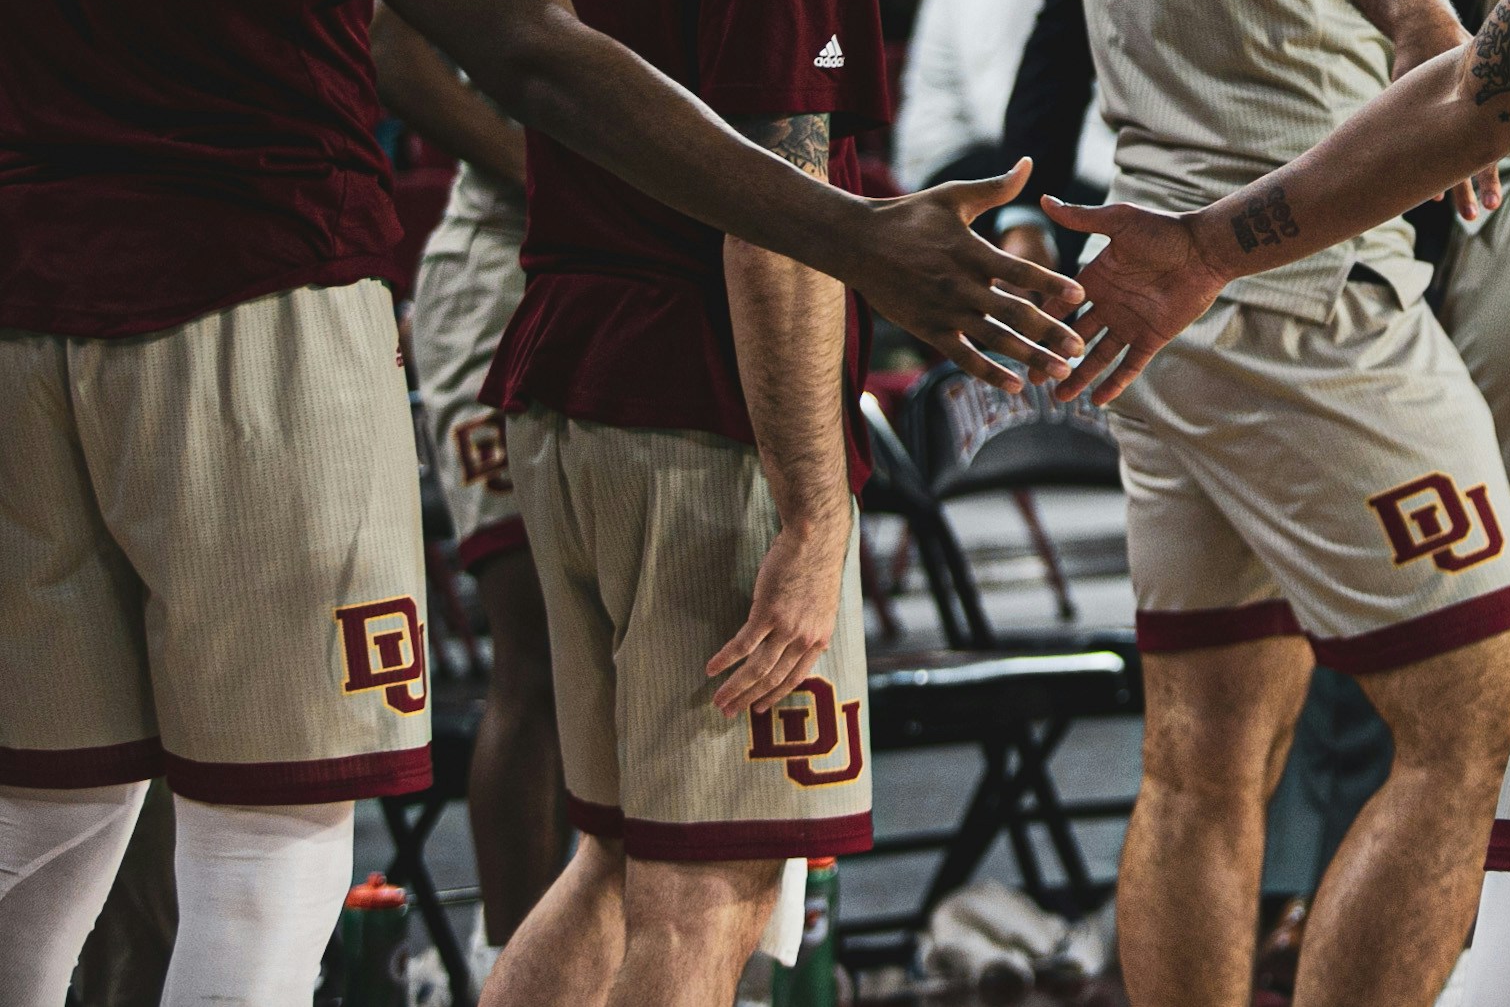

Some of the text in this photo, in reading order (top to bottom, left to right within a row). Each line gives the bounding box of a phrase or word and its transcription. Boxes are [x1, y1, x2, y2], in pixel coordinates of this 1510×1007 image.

[813, 56, 846, 69] adida
[1366, 471, 1505, 576] DU
[335, 595, 428, 715] DU
[745, 675, 864, 788] DU
